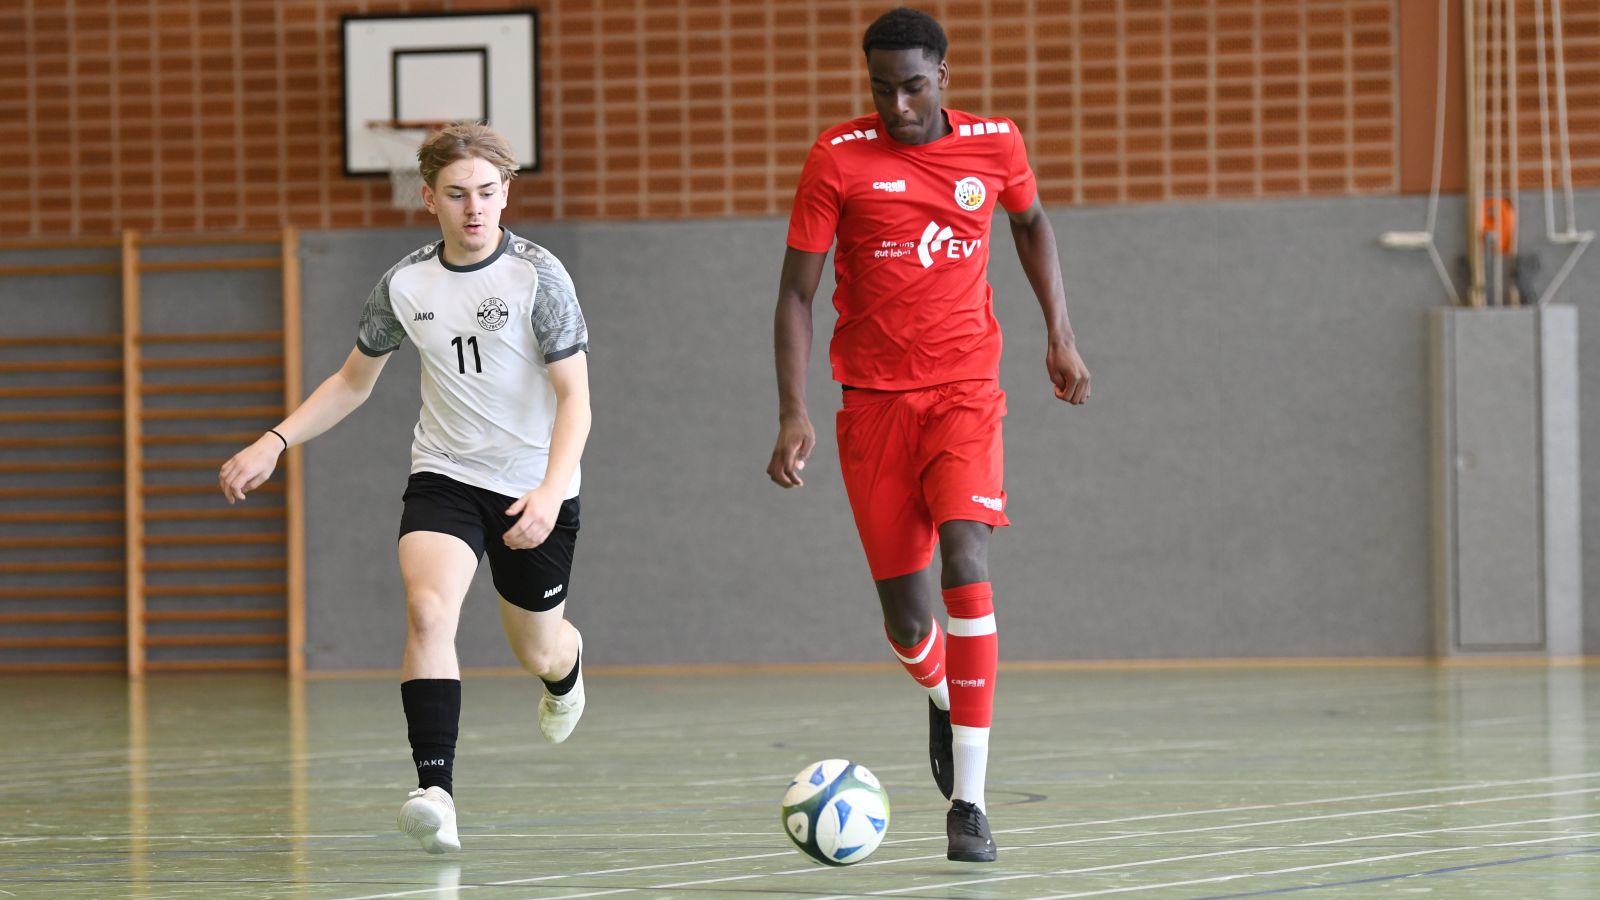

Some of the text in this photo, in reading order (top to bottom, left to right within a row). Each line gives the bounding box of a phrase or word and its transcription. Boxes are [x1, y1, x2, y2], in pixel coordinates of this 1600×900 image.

[874, 249, 888, 258] gut
[414, 311, 434, 321] JAKO
[451, 336, 482, 374] 11
[543, 583, 563, 599] JAKO
[418, 758, 445, 769] JAKO
